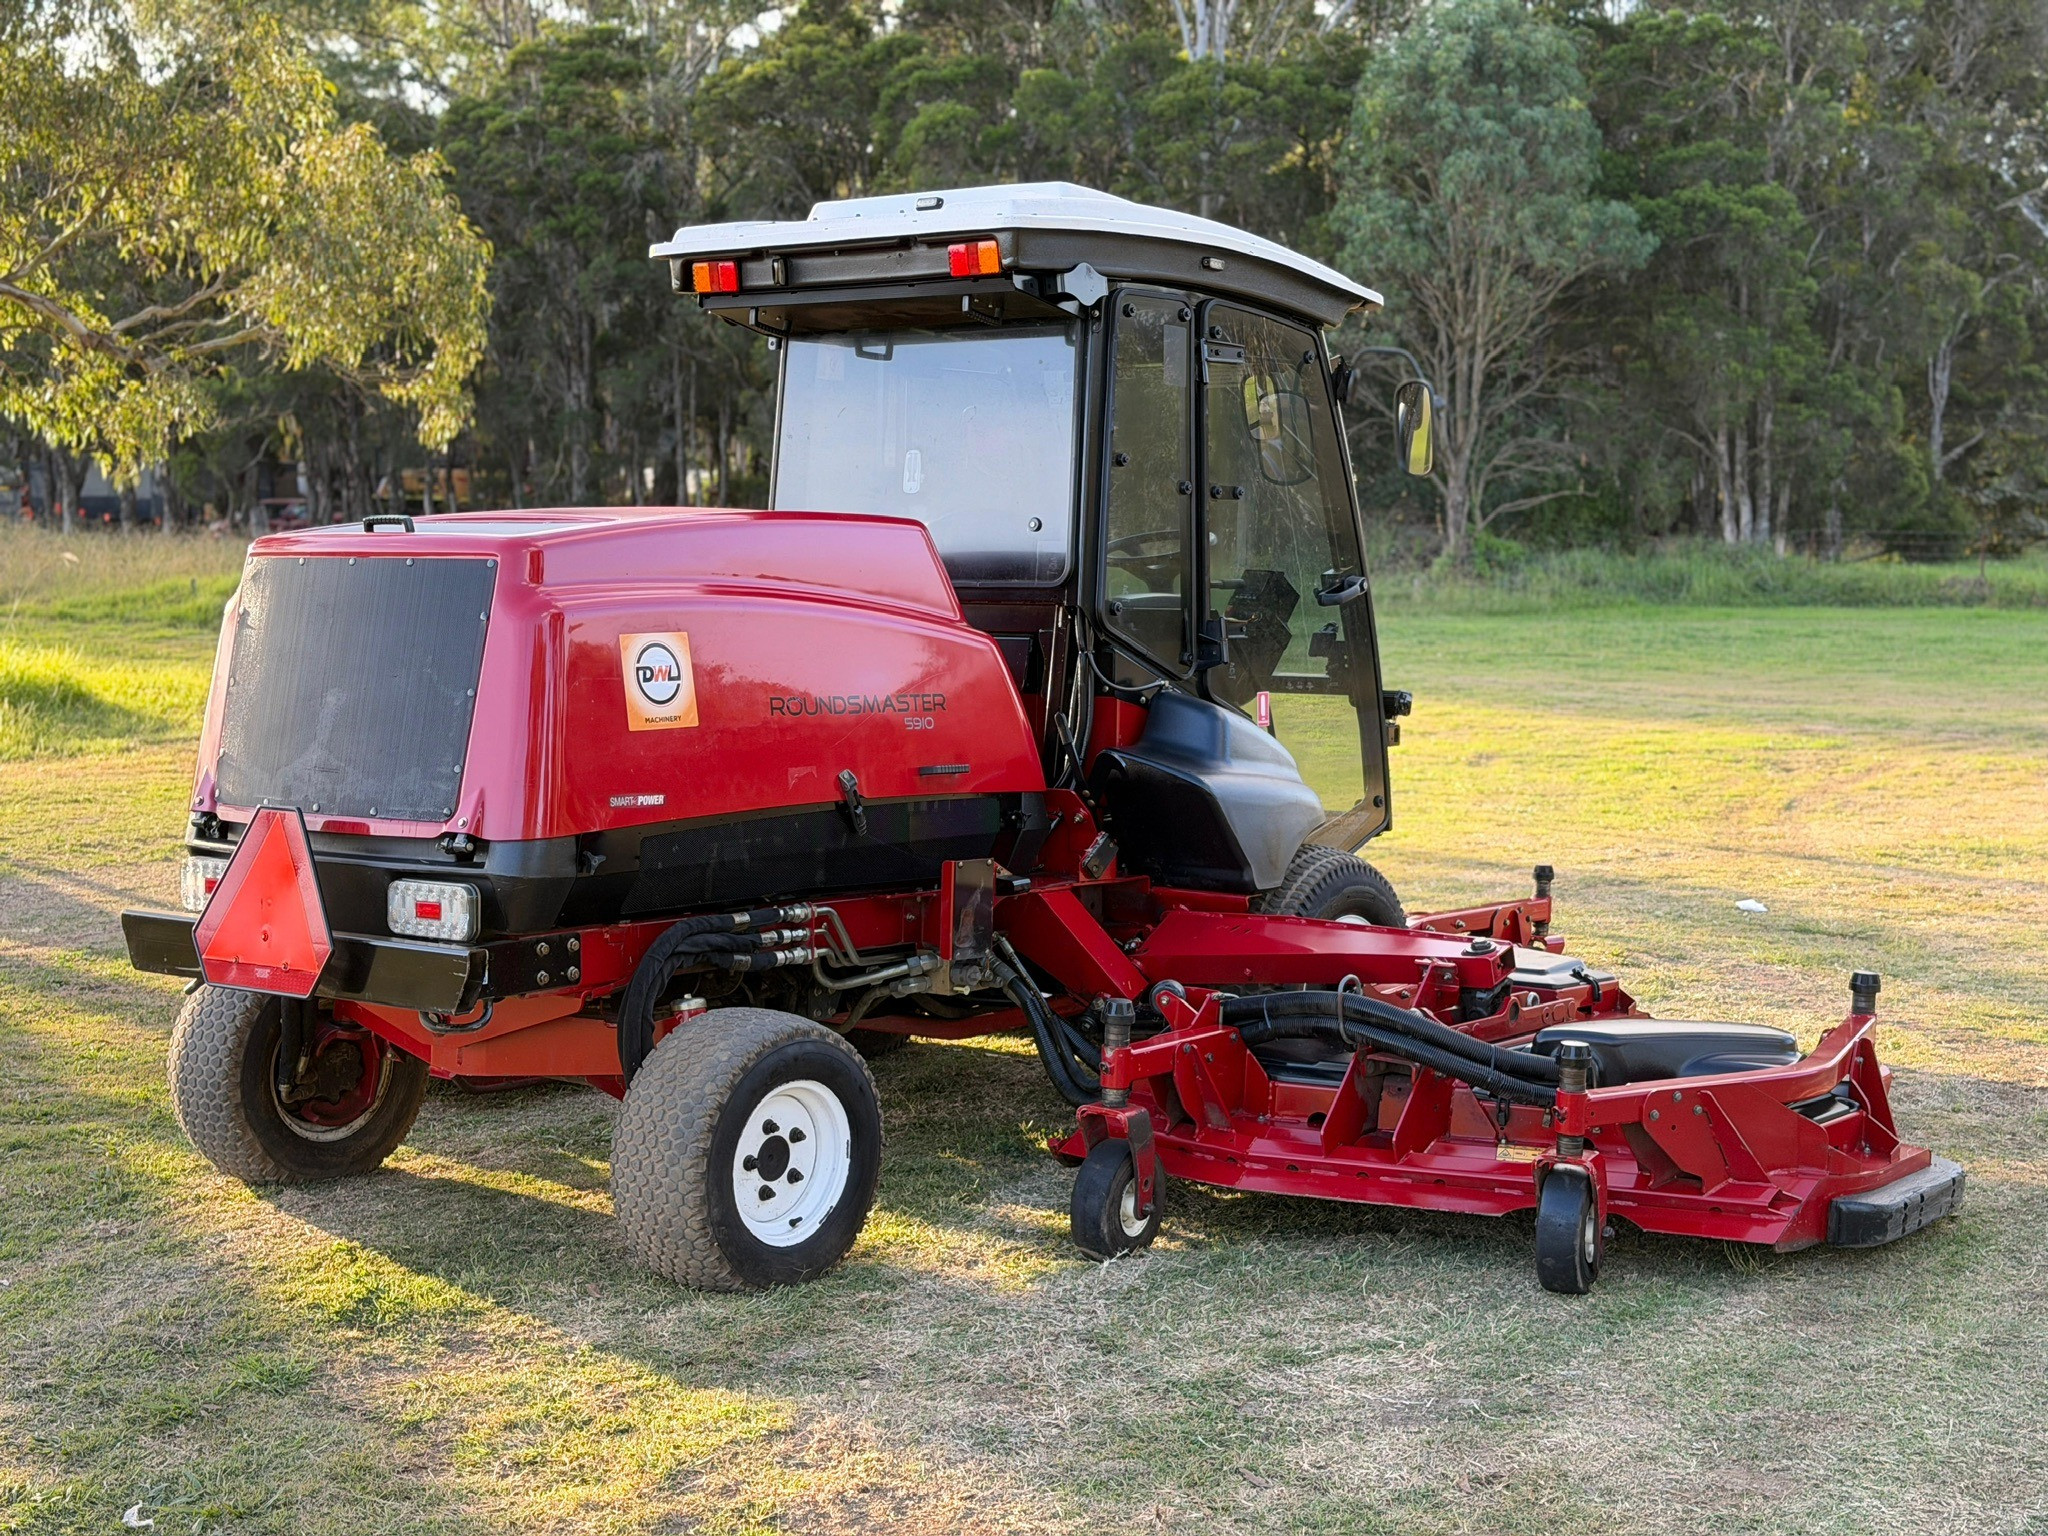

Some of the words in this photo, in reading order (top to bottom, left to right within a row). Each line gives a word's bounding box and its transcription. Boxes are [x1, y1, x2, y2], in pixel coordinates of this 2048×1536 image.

[636, 664, 681, 683] DWL
[769, 693, 947, 717] ROUNDSMASTER
[644, 715, 682, 724] MACHINERY
[904, 717, 935, 730] 5910
[610, 796, 634, 807] SMART
[637, 794, 665, 806] POWER
